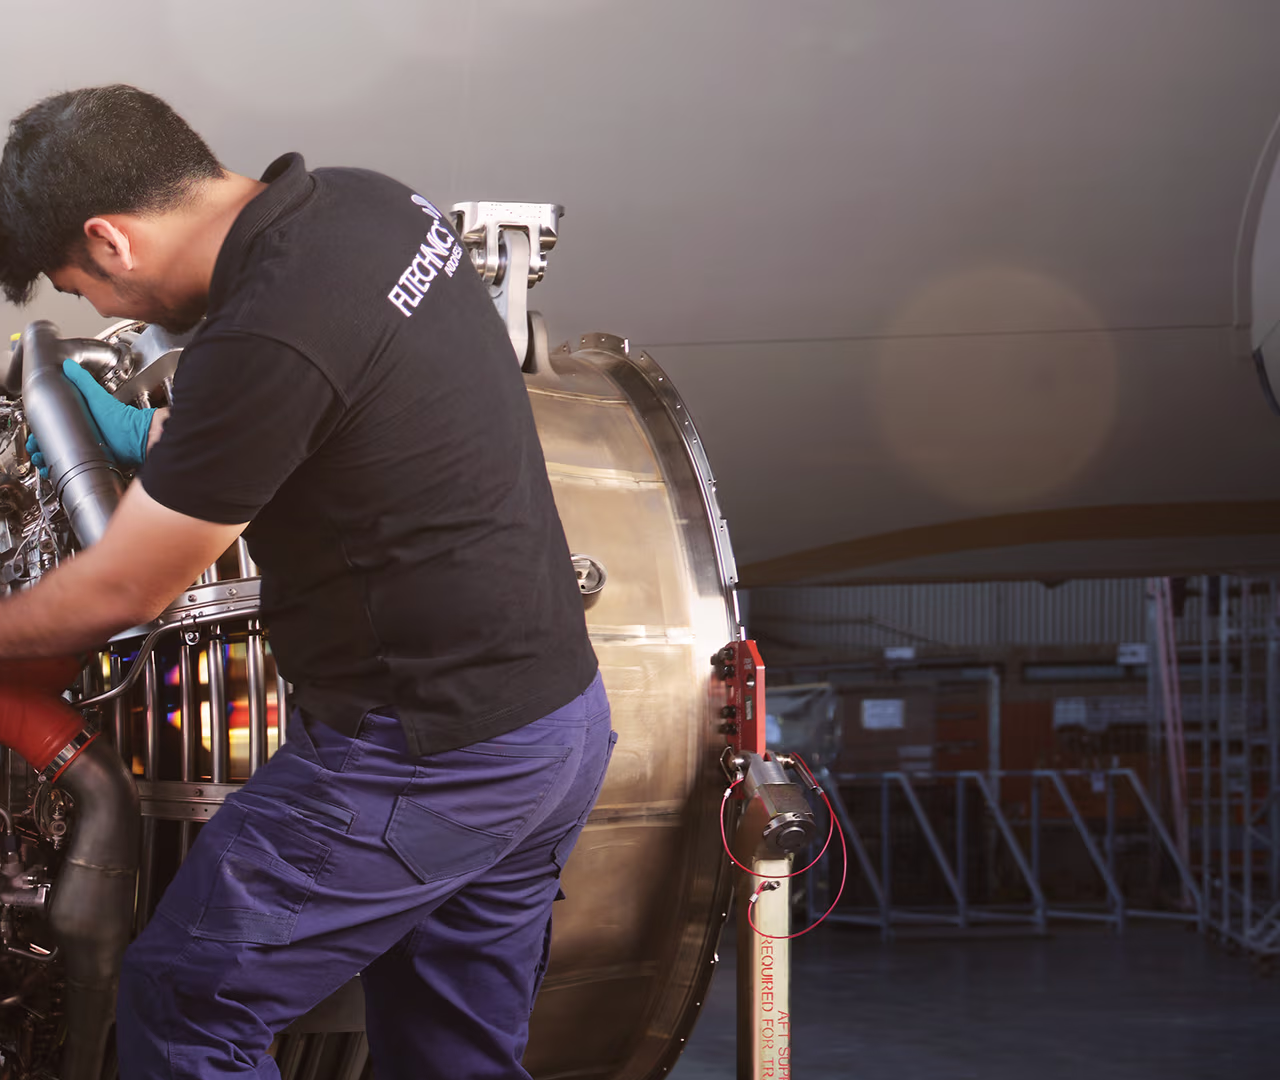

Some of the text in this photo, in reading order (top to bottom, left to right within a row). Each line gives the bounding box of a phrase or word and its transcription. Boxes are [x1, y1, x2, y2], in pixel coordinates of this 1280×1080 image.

[760, 934, 773, 1012] REQUIRED
[762, 1018, 774, 1050] FOR
[777, 1010, 790, 1039] AFT
